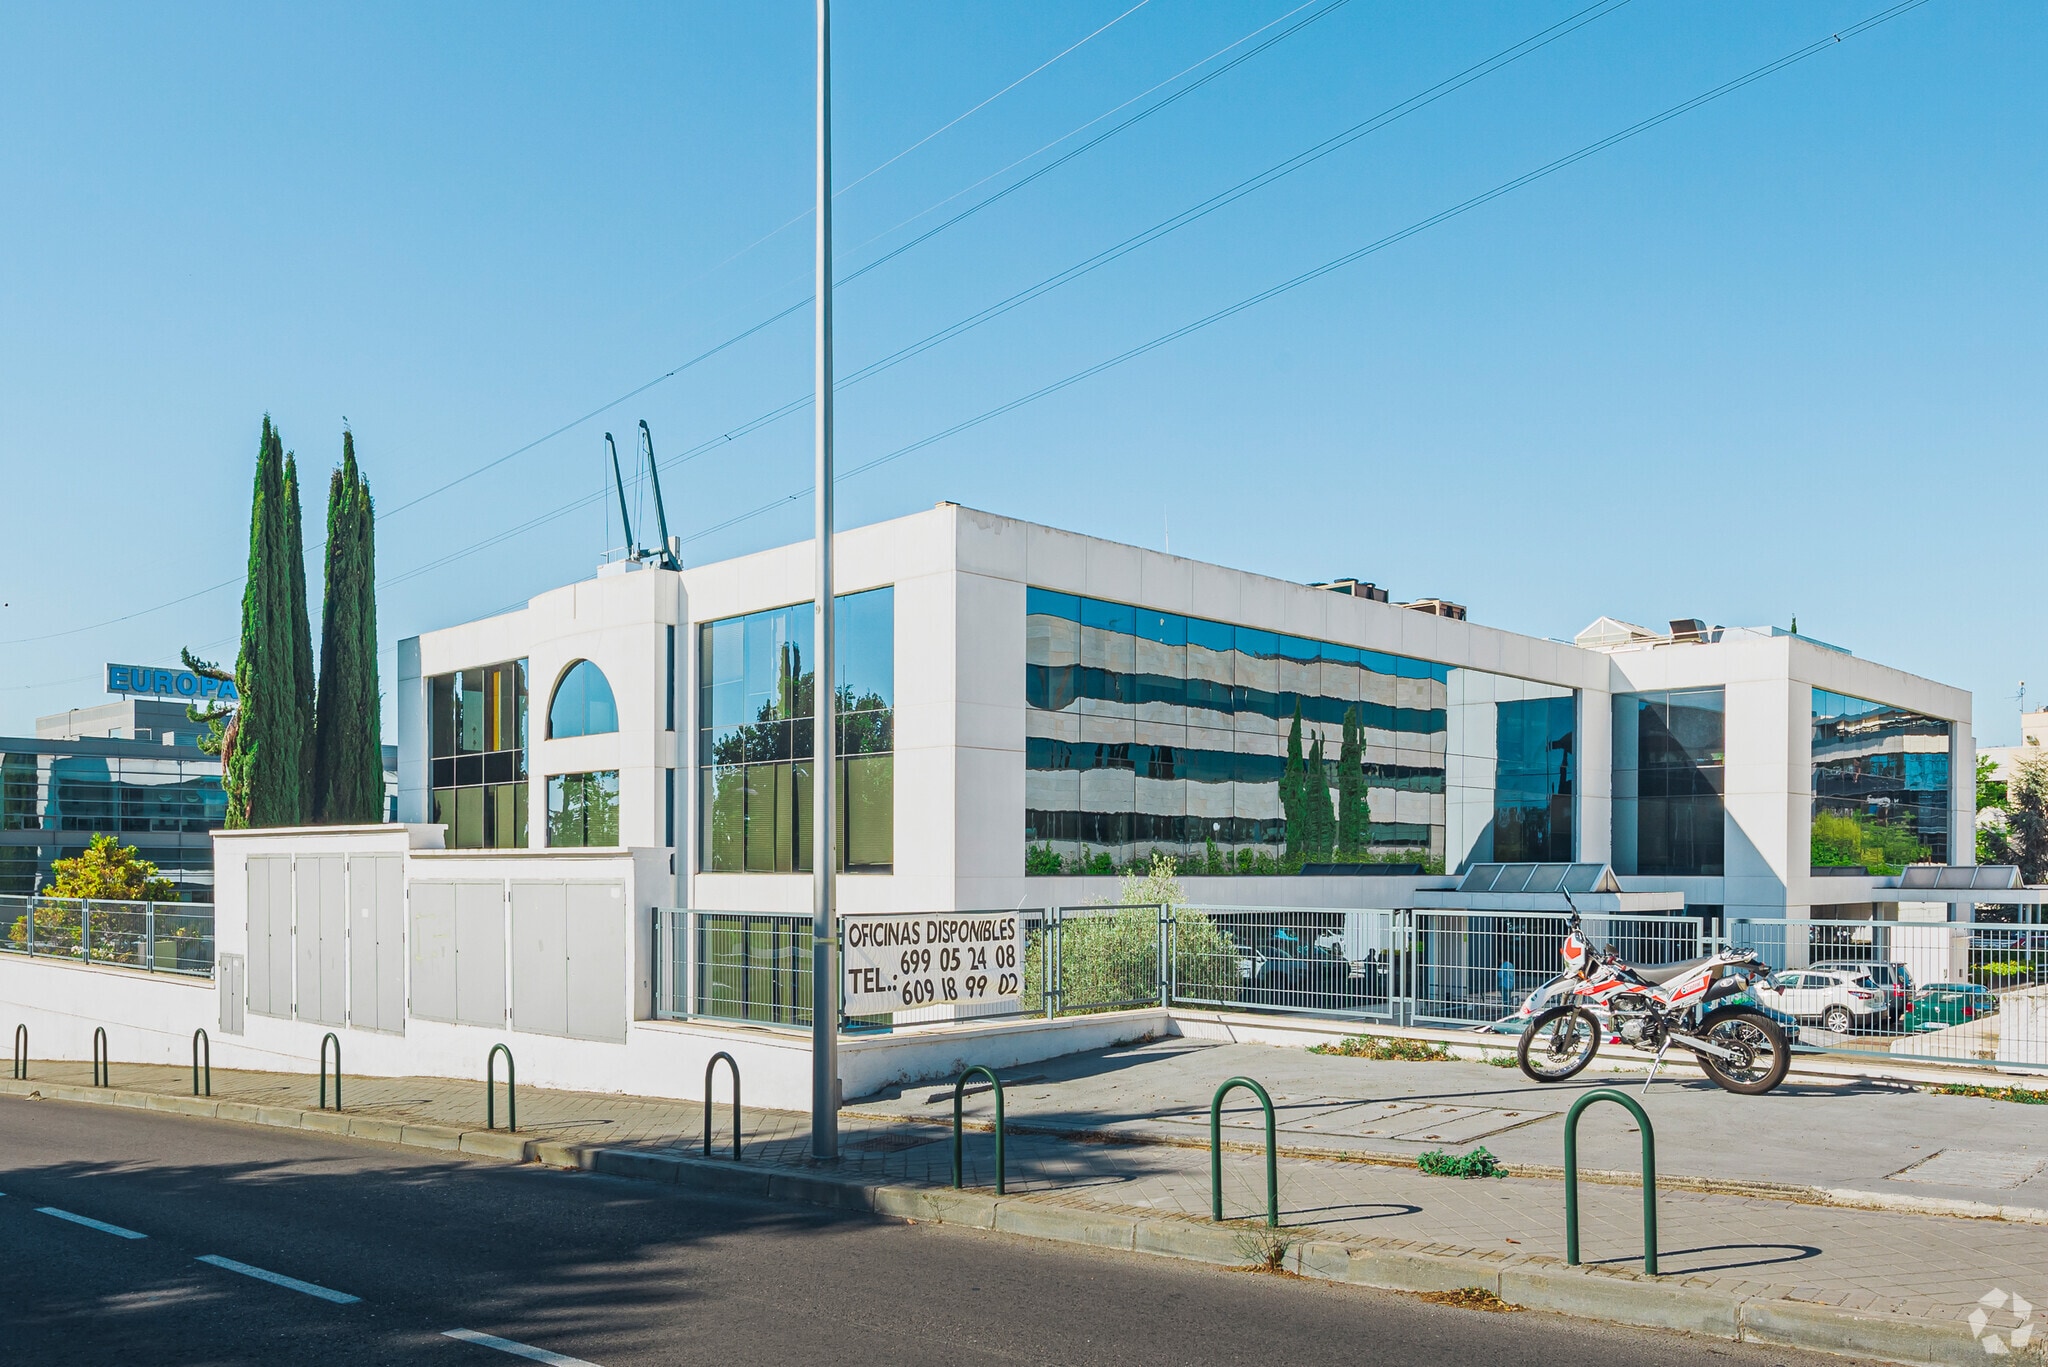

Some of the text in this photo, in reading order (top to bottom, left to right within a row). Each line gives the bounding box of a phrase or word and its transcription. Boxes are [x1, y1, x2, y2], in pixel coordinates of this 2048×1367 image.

[110, 667, 239, 699] EUROPA
[849, 918, 1015, 947] OFICINAS DISPONIBLES
[901, 944, 1016, 975] 699 05 24 08
[848, 968, 898, 994] TEL.:
[902, 973, 1018, 1005] 609 18 99 02
